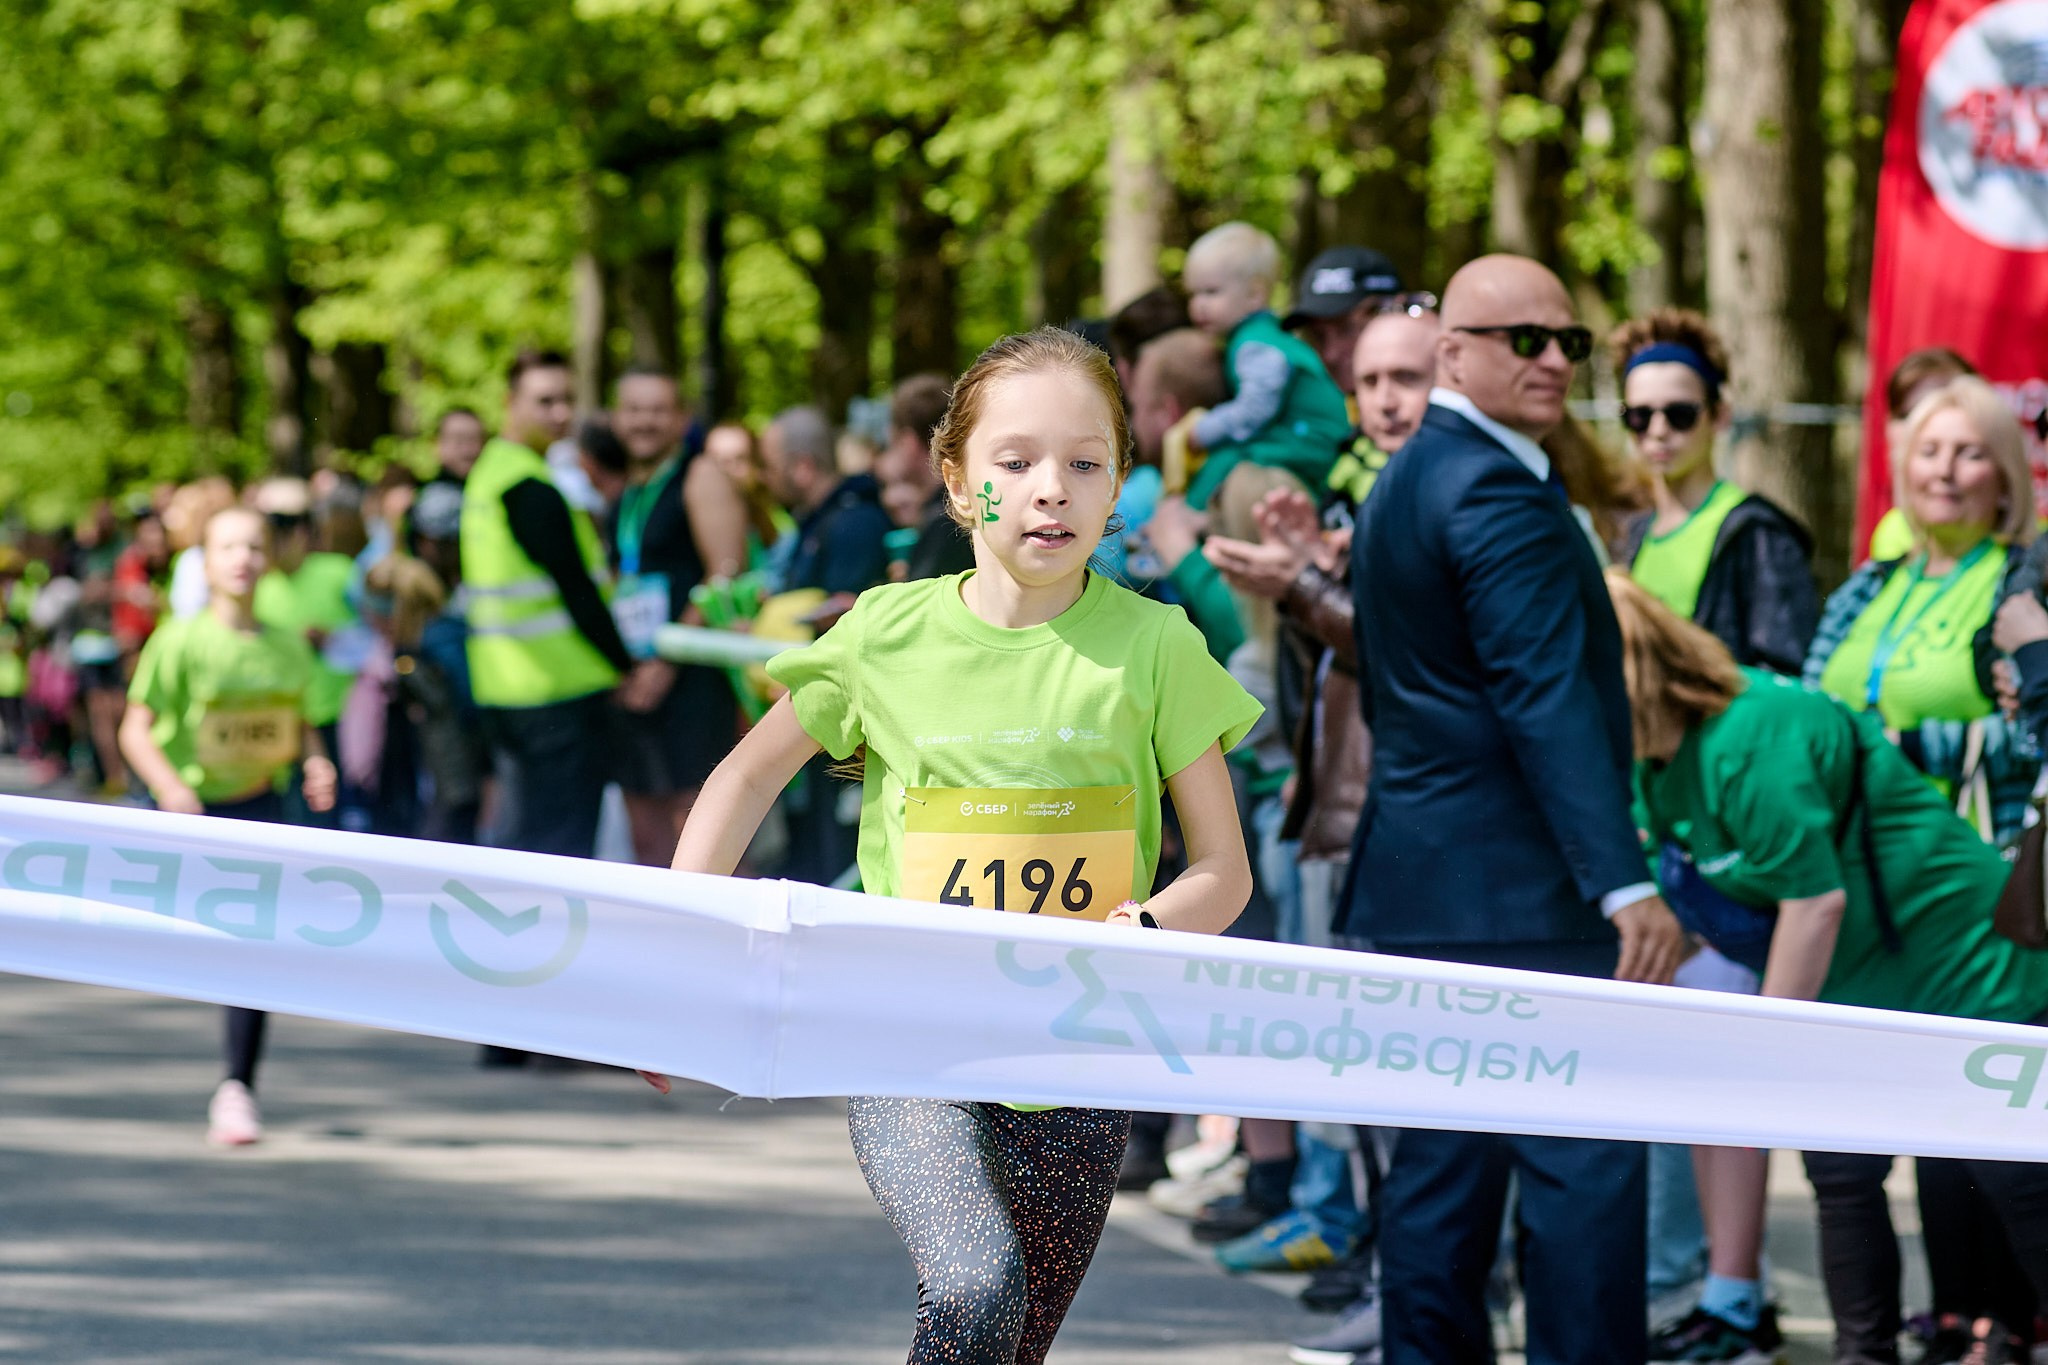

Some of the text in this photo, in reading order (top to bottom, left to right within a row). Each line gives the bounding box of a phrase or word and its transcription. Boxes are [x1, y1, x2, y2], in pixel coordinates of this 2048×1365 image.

[951, 735, 973, 743] KIDS
[976, 804, 1008, 814] СБЕР
[1027, 801, 1060, 809] зелёный
[940, 857, 1093, 914] 4196
